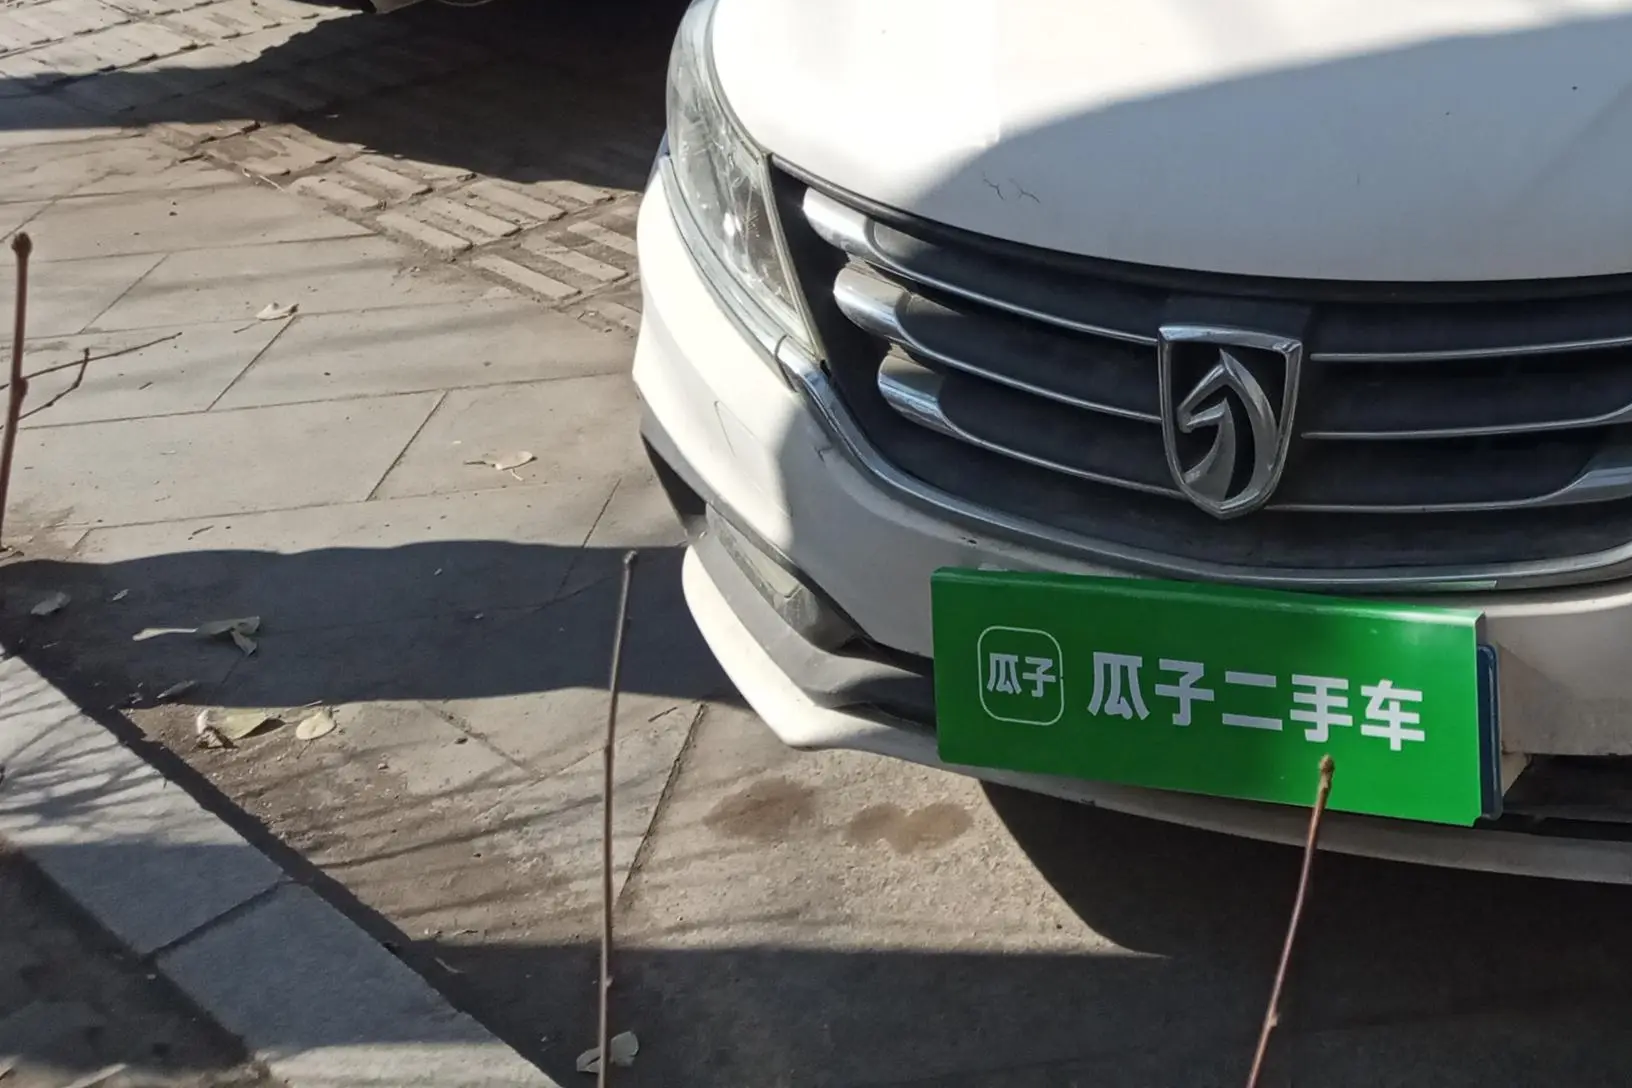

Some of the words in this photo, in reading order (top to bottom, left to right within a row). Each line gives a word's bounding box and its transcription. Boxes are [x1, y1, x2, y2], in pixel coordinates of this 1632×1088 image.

[986, 652, 1057, 698] 瓜子
[1087, 651, 1426, 751] 瓜子二手车
